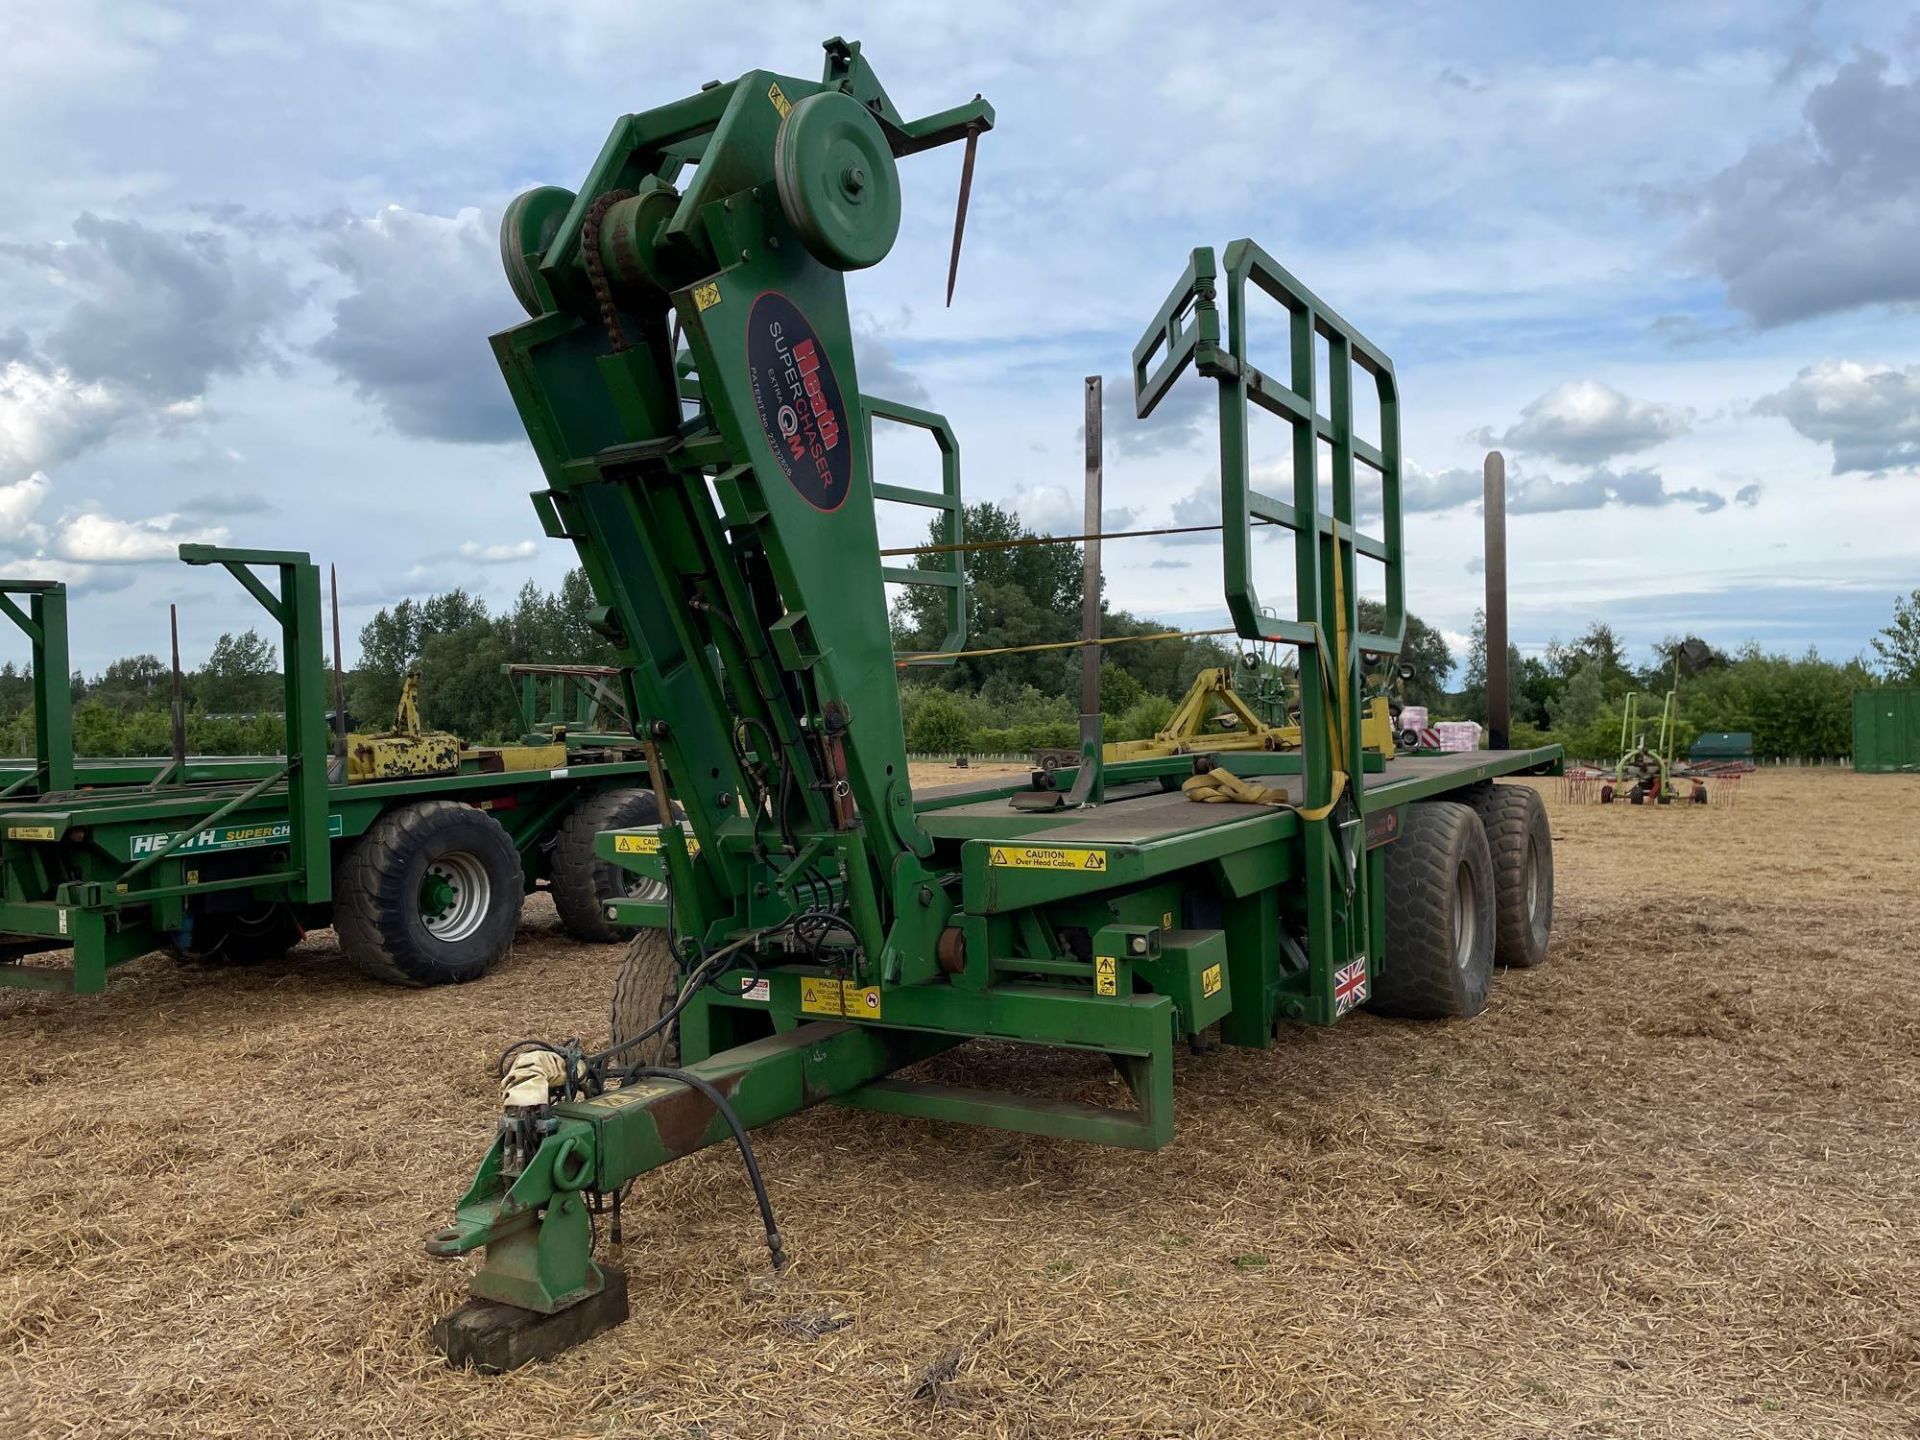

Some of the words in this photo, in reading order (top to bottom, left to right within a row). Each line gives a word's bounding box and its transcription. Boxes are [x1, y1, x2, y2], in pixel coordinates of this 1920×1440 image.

[751, 367, 764, 411] PATENT
[767, 368, 783, 404] EXTRA
[793, 338, 839, 451] Heath
[769, 322, 833, 489] SUPERCHASER
[226, 825, 291, 841] SUPERCH
[1016, 858, 1032, 866] Over
[1053, 859, 1076, 867] Cables
[1026, 849, 1065, 859] CAUTION
